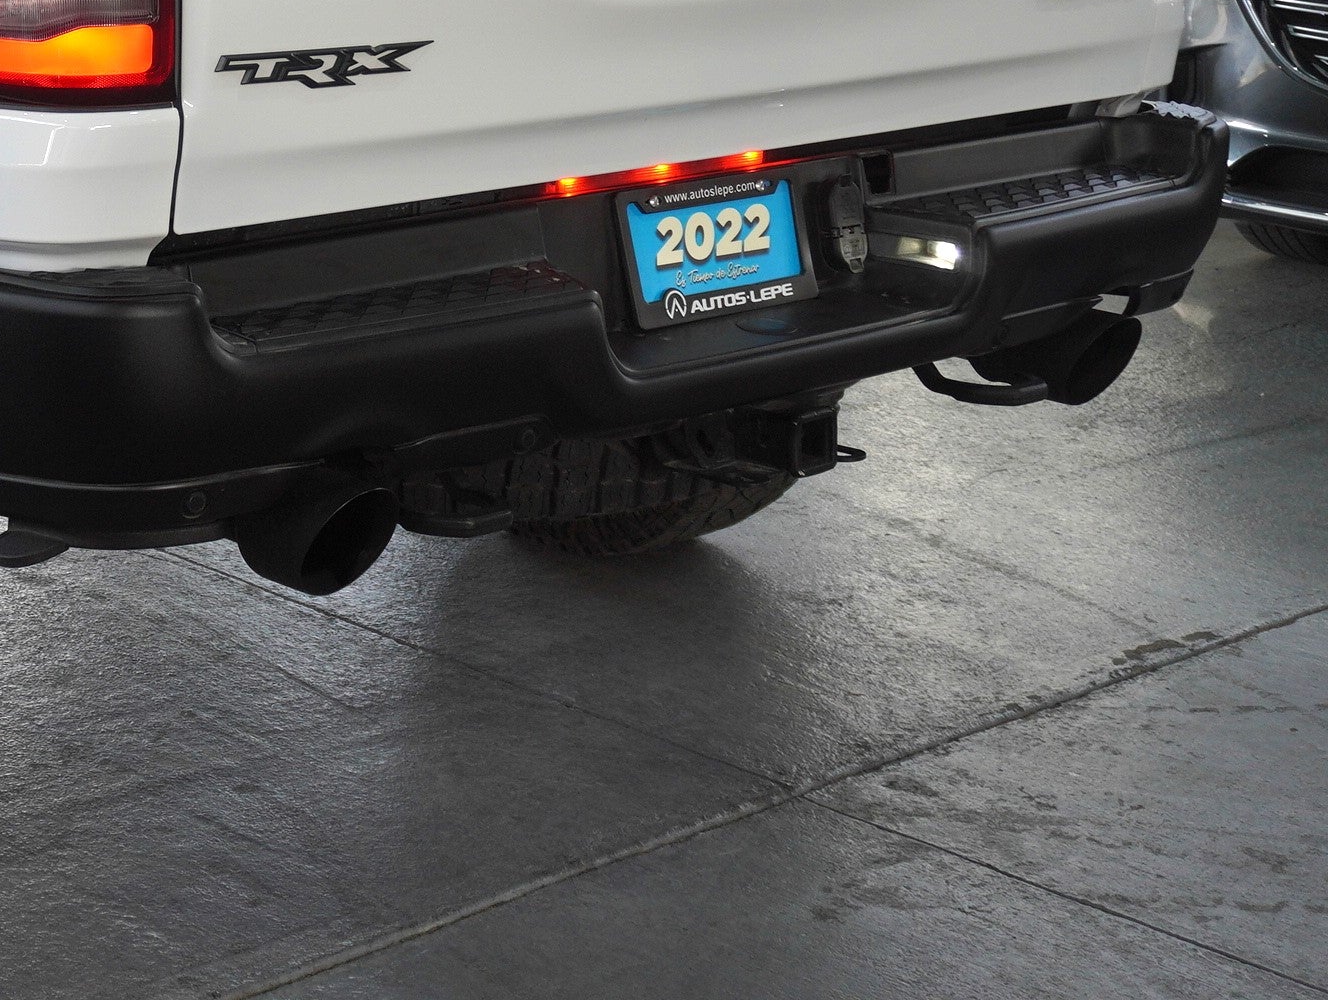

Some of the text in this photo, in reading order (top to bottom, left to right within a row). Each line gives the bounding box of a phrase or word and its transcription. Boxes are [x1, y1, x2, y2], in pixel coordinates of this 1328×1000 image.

[214, 40, 434, 89] TRX
[664, 181, 756, 203] www.autoslepe.com
[656, 203, 771, 267] 2022
[688, 268, 714, 283] Tiempo
[716, 268, 726, 279] de
